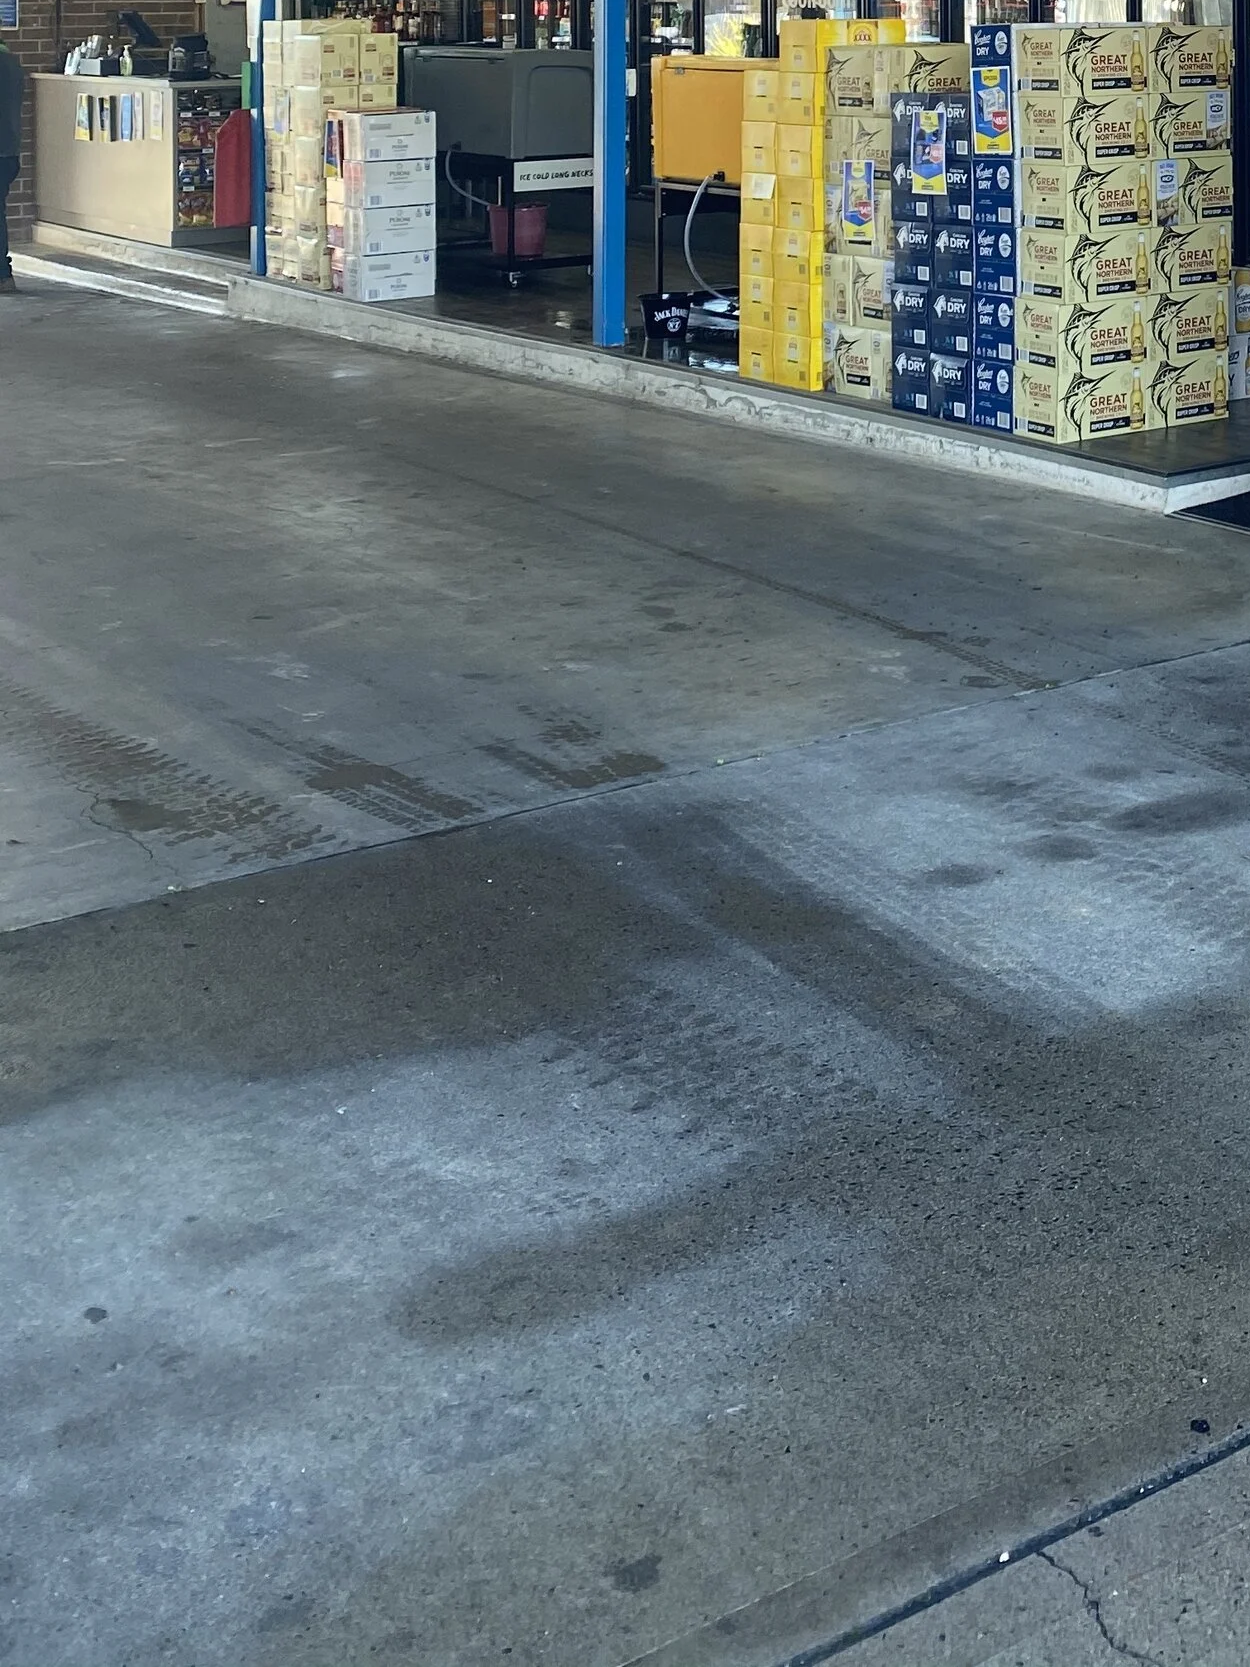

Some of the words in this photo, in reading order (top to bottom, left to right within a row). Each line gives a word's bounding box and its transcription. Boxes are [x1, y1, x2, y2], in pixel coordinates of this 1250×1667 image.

[853, 34, 872, 42] XXXX
[976, 46, 989, 56] DRY
[1030, 42, 1052, 50] GREAT
[1091, 54, 1127, 65] GREAT
[1178, 52, 1213, 63] GREAT
[1091, 65, 1128, 73] NORTHERN
[1179, 63, 1214, 71] NORTHERN
[837, 77, 860, 86] GREAT
[928, 77, 962, 88] GREAT
[947, 106, 966, 119] DRY
[1033, 109, 1056, 118] GREAT
[1095, 121, 1131, 133] GREAT
[1173, 121, 1203, 131] GREAT
[1095, 132, 1132, 141] NORTHERN
[1173, 130, 1203, 138] NORTHERN
[866, 149, 889, 159] GREAT
[532, 172, 549, 180] COLD
[551, 171, 570, 179] LONG
[571, 168, 593, 178] NECKS
[946, 172, 968, 184] DRY
[978, 180, 991, 189] DRY
[1036, 177, 1059, 186] GREAT
[1099, 188, 1134, 200] GREAT
[1202, 185, 1230, 196] GREAT
[1099, 200, 1135, 209] NORTHERN
[908, 233, 928, 246] DRY
[949, 238, 970, 250] DRY
[980, 246, 993, 256] DRY
[1034, 246, 1057, 255] GREAT
[1178, 249, 1214, 261] GREAT
[1096, 257, 1132, 270] GREAT
[1179, 260, 1214, 269] NORTHERN
[1096, 269, 1133, 278] NORTHERN
[862, 287, 881, 298] GREAT
[904, 296, 924, 309] DRY
[947, 301, 966, 314] DRY
[654, 309, 671, 322] JACK
[979, 315, 992, 325] DRY
[1031, 313, 1053, 323] GREAT
[1176, 315, 1212, 329] GREAT
[1090, 326, 1128, 340] GREAT
[1176, 327, 1212, 337] NORTHERN
[1090, 338, 1128, 348] NORTHERN
[845, 355, 868, 365] GREAT
[907, 360, 926, 373] DRY
[943, 368, 962, 382] DRY
[979, 380, 991, 391] DRY
[1029, 382, 1051, 391] GREAT
[1175, 380, 1211, 395] GREAT
[1090, 393, 1127, 407] GREAT
[1175, 392, 1211, 402] NORTHERN
[1090, 405, 1128, 416] NORTHERN
